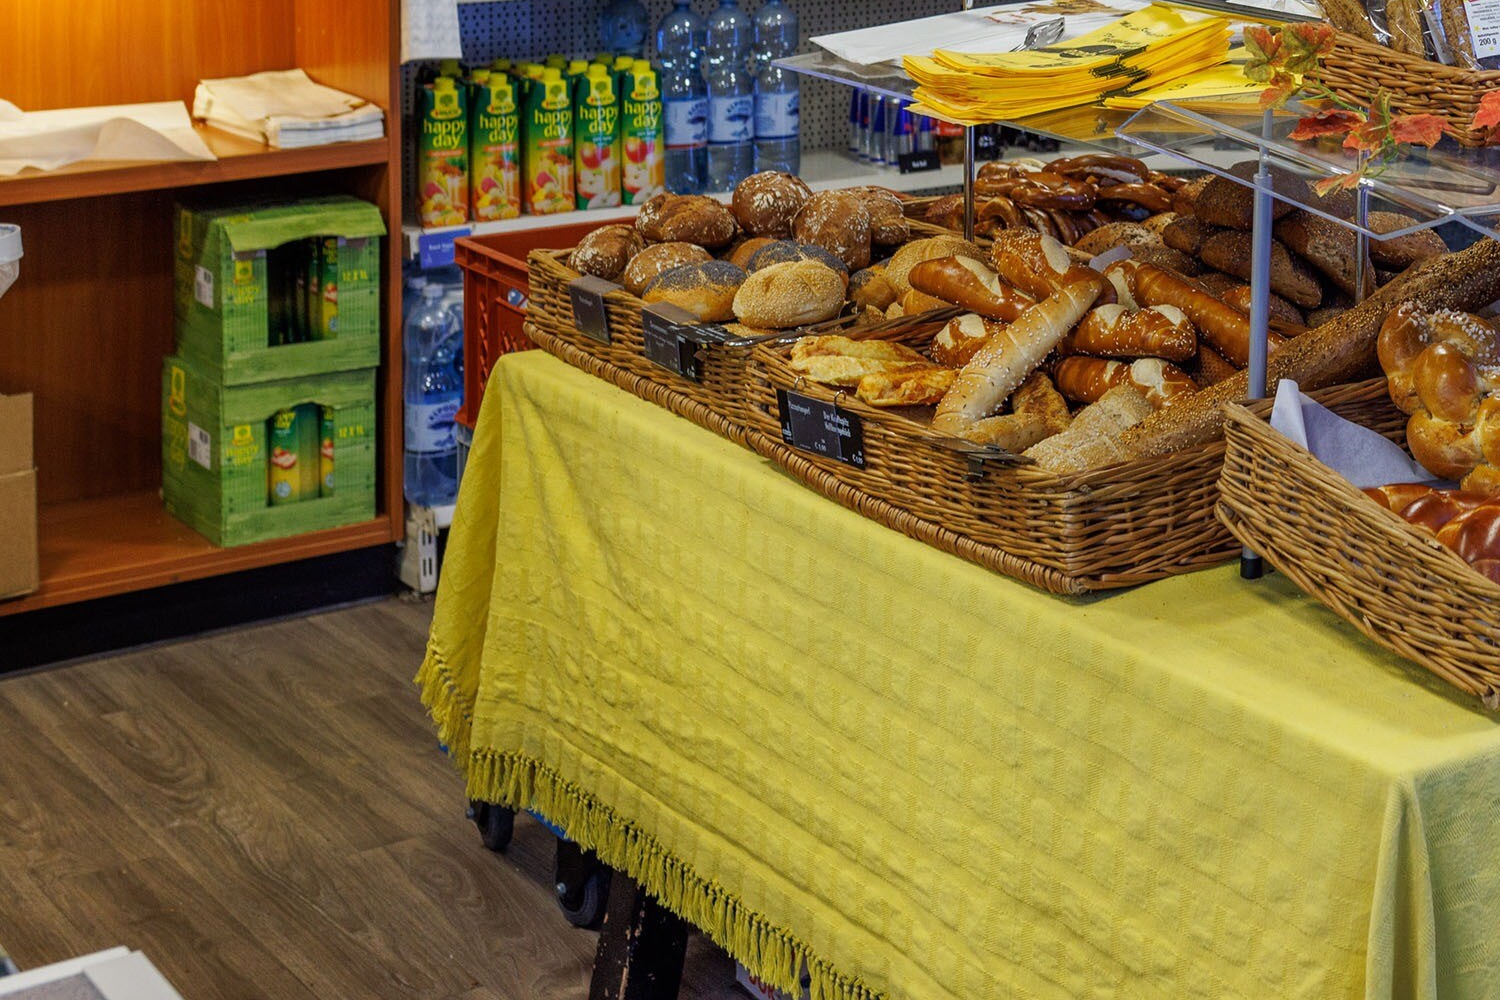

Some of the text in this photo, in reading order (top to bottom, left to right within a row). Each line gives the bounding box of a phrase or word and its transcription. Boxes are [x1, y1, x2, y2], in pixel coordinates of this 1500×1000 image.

[1479, 37, 1493, 47] 200
[579, 104, 619, 123] happy
[624, 100, 662, 117] happy
[479, 114, 518, 132] happy
[534, 109, 574, 126] happy
[633, 113, 659, 130] day
[424, 119, 467, 136] happy
[488, 127, 516, 144] day
[543, 122, 570, 139] day
[588, 119, 615, 135] day
[432, 132, 462, 149] day
